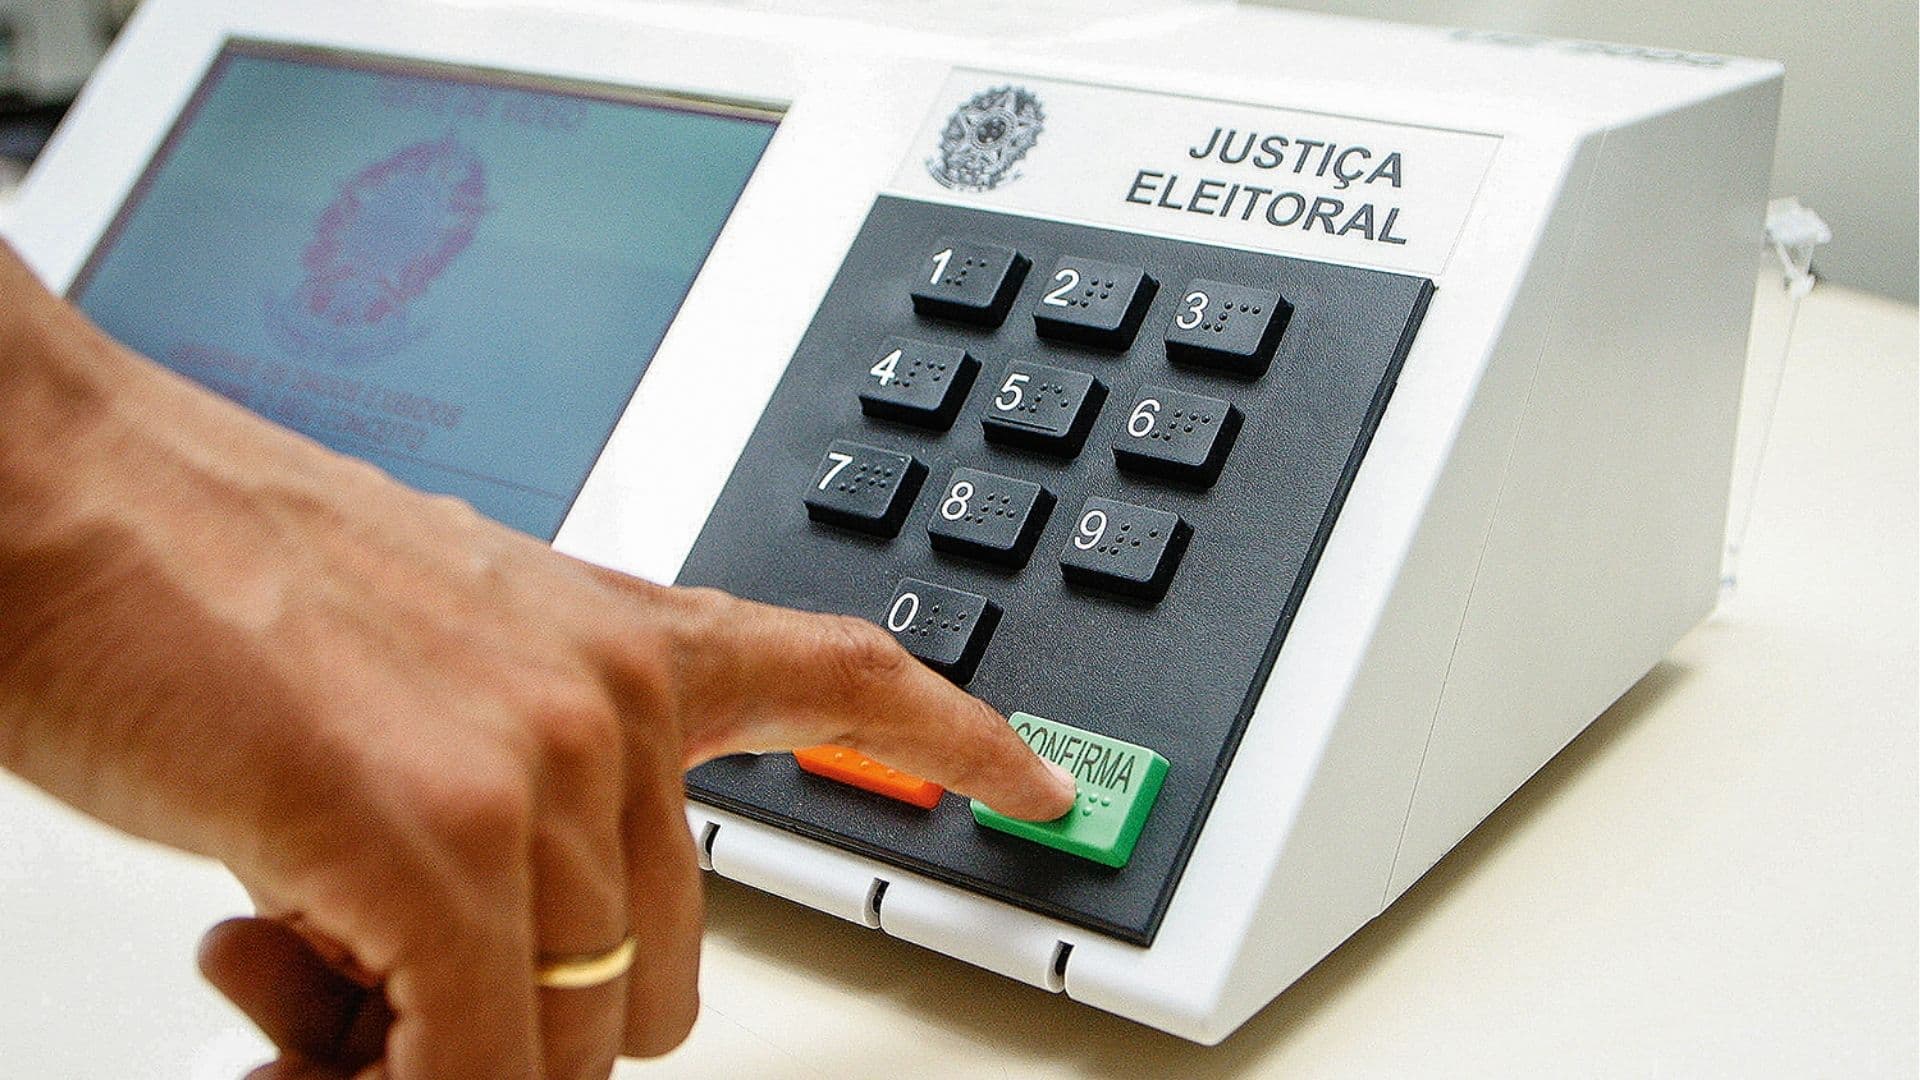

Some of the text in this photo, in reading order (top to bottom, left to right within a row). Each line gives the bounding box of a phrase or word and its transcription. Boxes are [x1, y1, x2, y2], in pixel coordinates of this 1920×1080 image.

[1189, 128, 1402, 190] JUSTIÇA
[1125, 170, 1408, 245] ELEITORAL
[929, 248, 953, 285] 1
[1043, 268, 1080, 307] 2
[1176, 291, 1209, 330] 3
[869, 349, 902, 387] 4
[995, 373, 1030, 411] 5
[1127, 398, 1161, 438] 6
[818, 451, 854, 490] 7
[941, 481, 974, 521] 8
[1074, 510, 1108, 550] 9
[887, 592, 920, 632] 0
